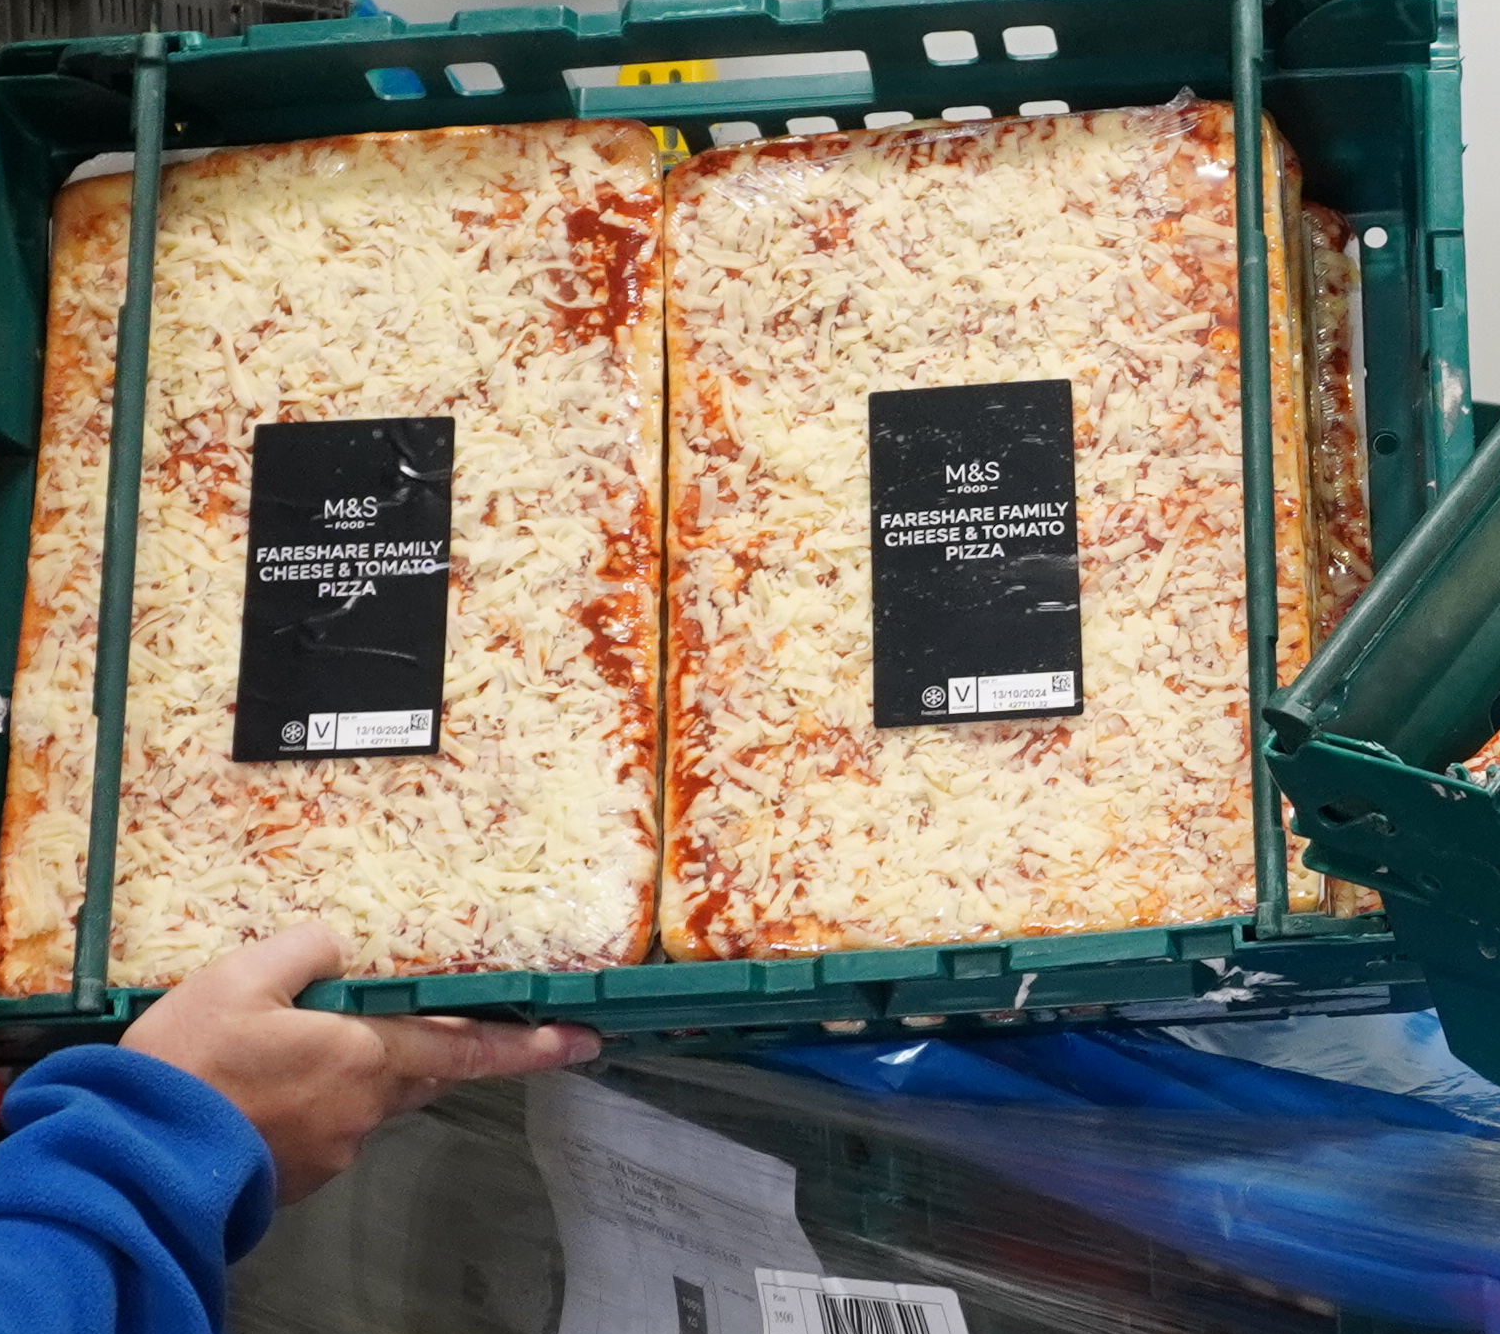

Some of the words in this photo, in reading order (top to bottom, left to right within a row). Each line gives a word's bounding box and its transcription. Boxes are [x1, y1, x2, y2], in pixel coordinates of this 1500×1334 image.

[946, 461, 1000, 485] M&S
[957, 484, 988, 494] FOOD
[324, 496, 378, 519] M&S
[880, 506, 995, 529] FARESHARE
[999, 502, 1069, 520] FAMILY
[335, 520, 365, 530] FOOD
[884, 526, 961, 547] CHEESE
[964, 526, 978, 541] &
[982, 521, 1065, 539] TOMATO
[256, 543, 369, 563] FARESHARE
[374, 540, 442, 559] FAMILY
[946, 543, 1005, 561] PIZZA
[259, 563, 334, 581] CHEESE
[339, 562, 350, 577] &
[357, 559, 437, 577] TOMATO
[318, 581, 376, 598] PIZZA
[954, 685, 971, 703] V
[992, 689, 1047, 699] 13/10/2024
[314, 721, 331, 739] V
[356, 725, 409, 735] 13/10/2024
